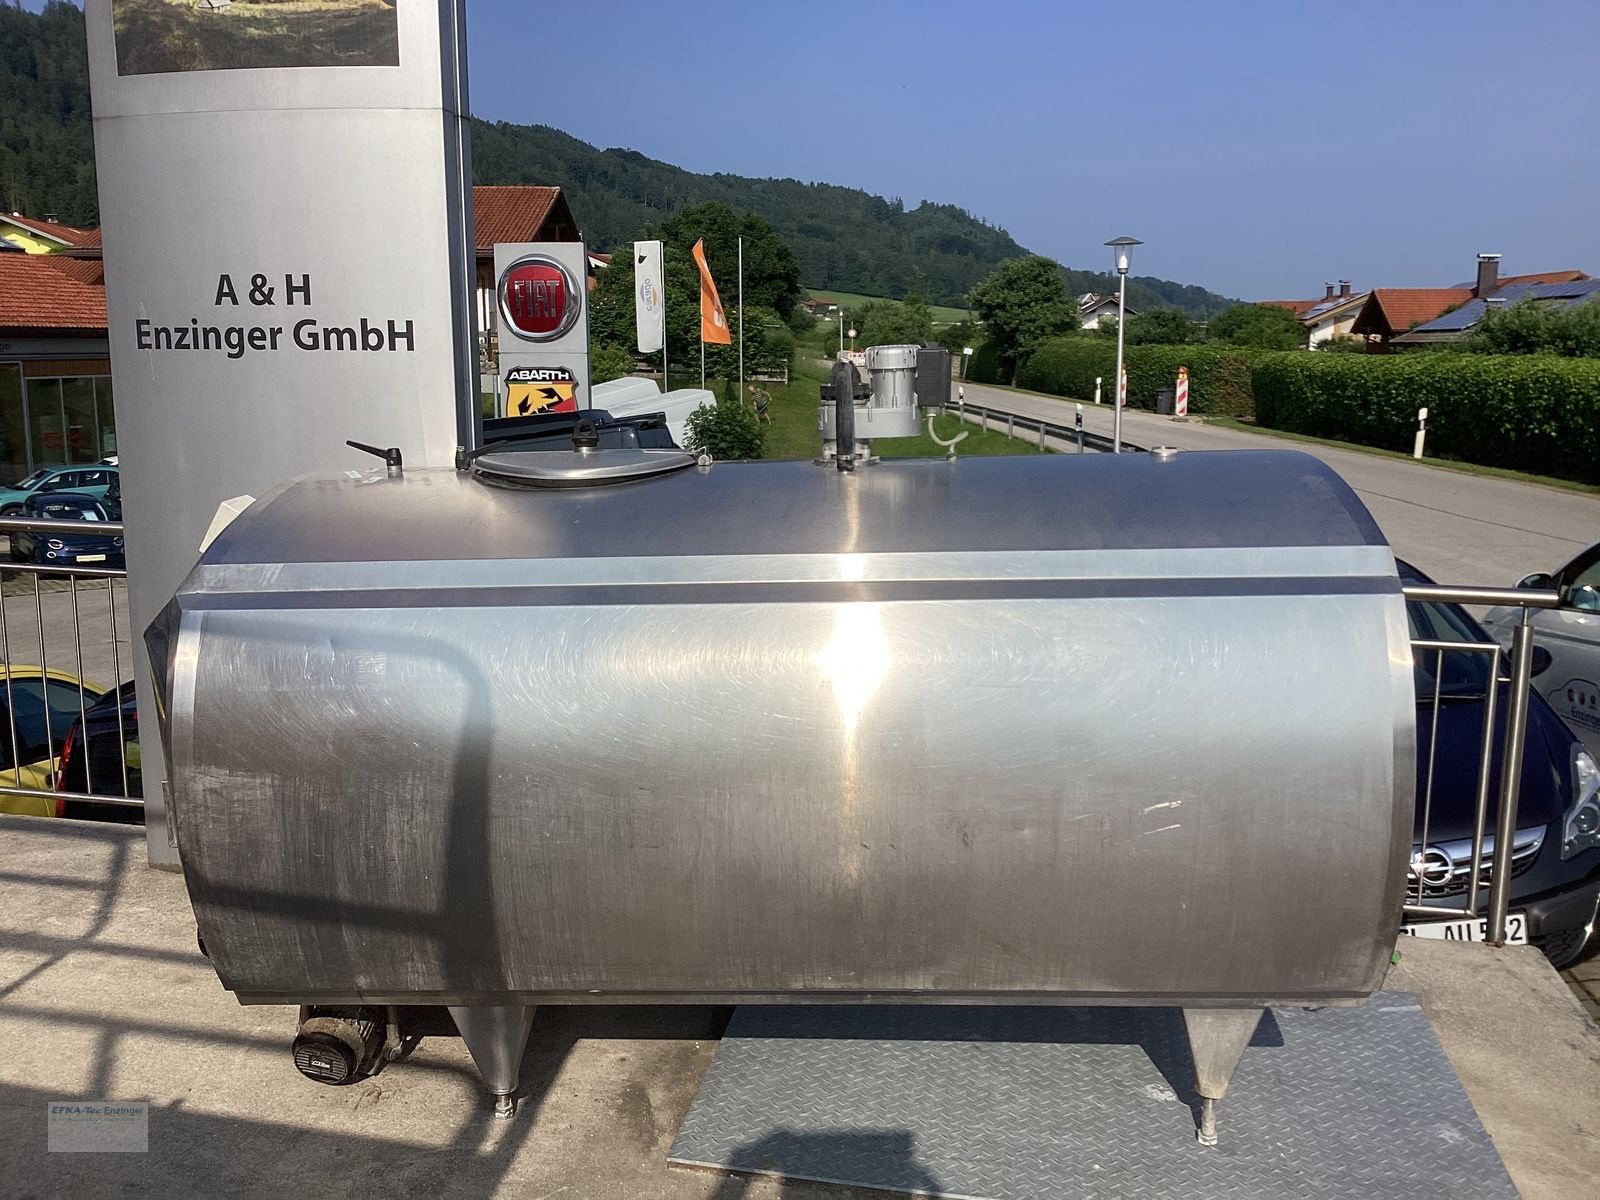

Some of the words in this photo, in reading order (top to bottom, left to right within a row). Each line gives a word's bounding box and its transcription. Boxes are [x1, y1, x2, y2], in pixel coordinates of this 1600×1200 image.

[214, 274, 239, 306] A
[248, 273, 276, 306] &
[285, 274, 312, 306] H
[514, 280, 560, 318] FIAT
[135, 318, 283, 359] Enzinger
[292, 318, 415, 351] GmbH
[509, 369, 570, 381] ABARTH
